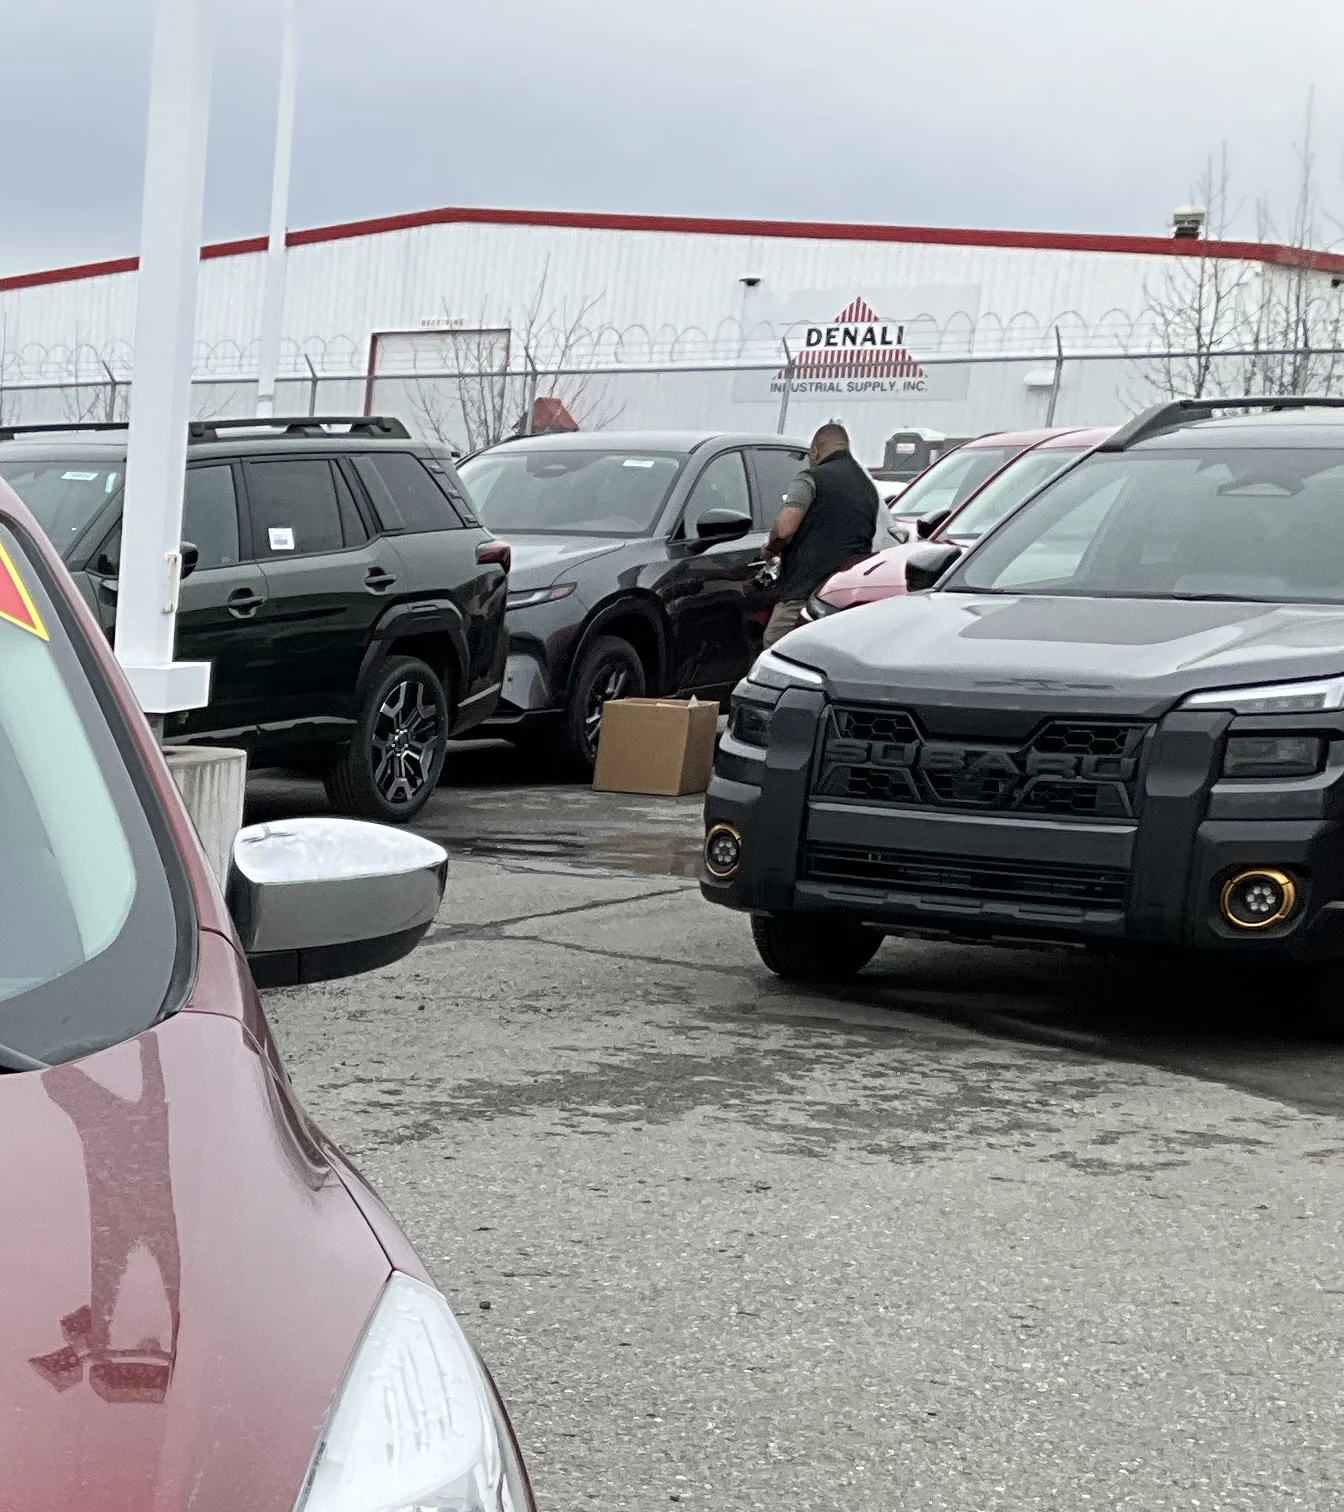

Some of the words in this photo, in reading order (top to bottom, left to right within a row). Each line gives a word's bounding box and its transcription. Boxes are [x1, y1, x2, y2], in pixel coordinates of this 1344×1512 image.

[806, 326, 904, 347] DENALI
[903, 380, 928, 392] INC.
[825, 738, 1135, 780] SUBARU
